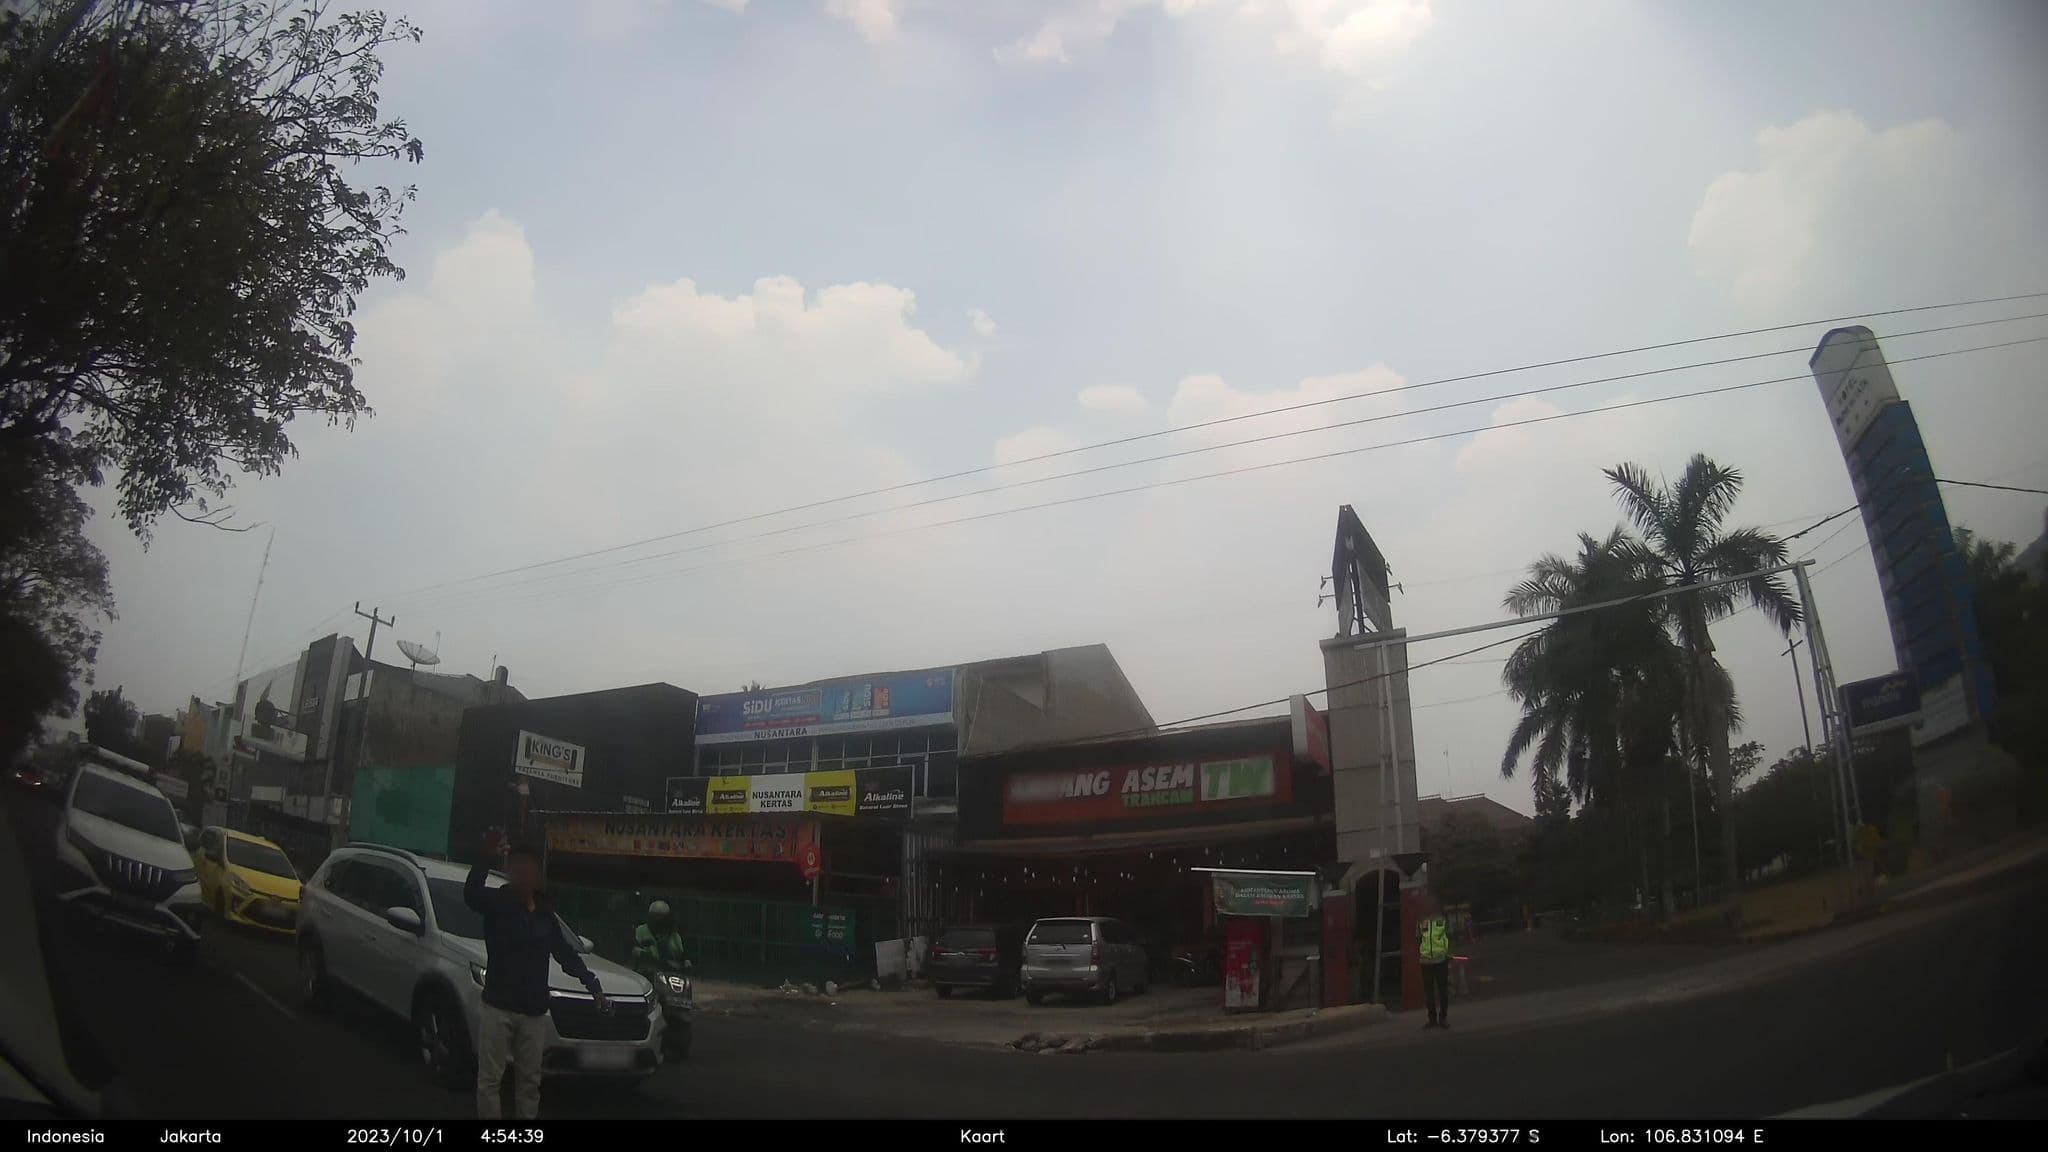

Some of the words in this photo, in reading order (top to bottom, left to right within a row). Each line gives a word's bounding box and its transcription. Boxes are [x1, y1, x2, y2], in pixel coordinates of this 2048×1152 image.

[743, 699, 774, 716] SiDU
[754, 727, 808, 739] NUSANTARA
[531, 739, 571, 761] KING'S
[1121, 763, 1194, 793] ASEM
[752, 790, 802, 800] NUSANTARA
[863, 791, 905, 802] Alkaline
[760, 799, 793, 808] KERTAS
[605, 822, 707, 838] NUSANTARA
[711, 823, 787, 839] KERTAS
